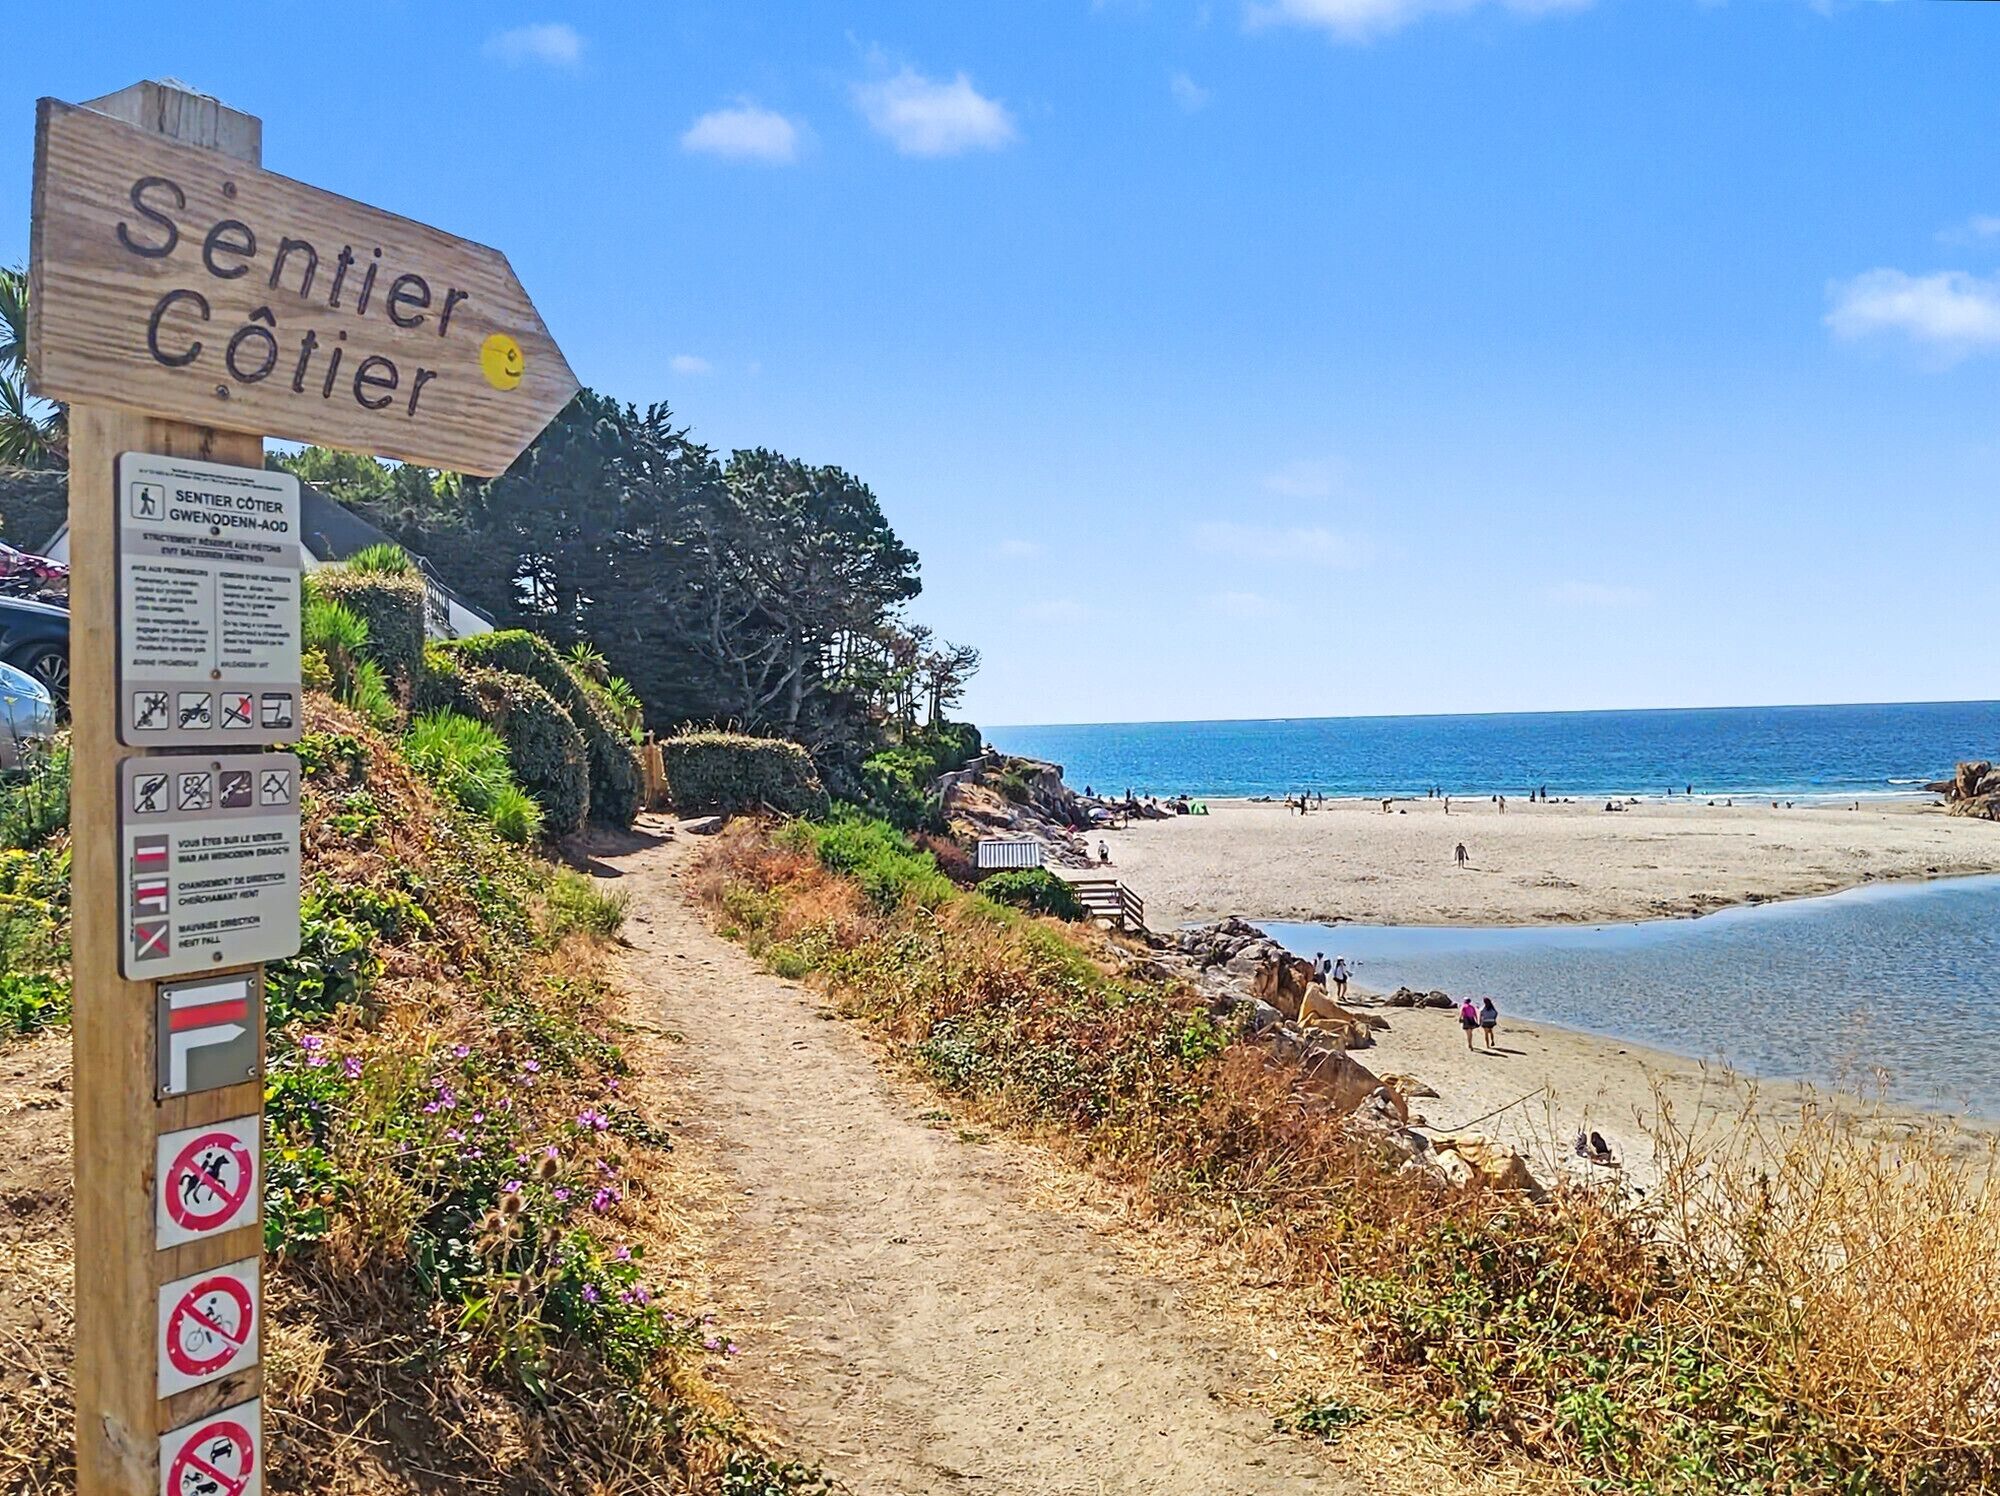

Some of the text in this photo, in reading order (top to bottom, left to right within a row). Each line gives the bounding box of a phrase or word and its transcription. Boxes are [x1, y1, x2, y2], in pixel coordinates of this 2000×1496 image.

[115, 176, 469, 338] Sentier
[147, 288, 437, 417] Côtier
[175, 489, 283, 514] SENTIER CÔTIER
[169, 508, 289, 533] GWENODENN-AOD
[178, 839, 200, 849] VOUS
[223, 836, 239, 846] SUR
[240, 834, 250, 844] LE
[234, 876, 245, 885] DE
